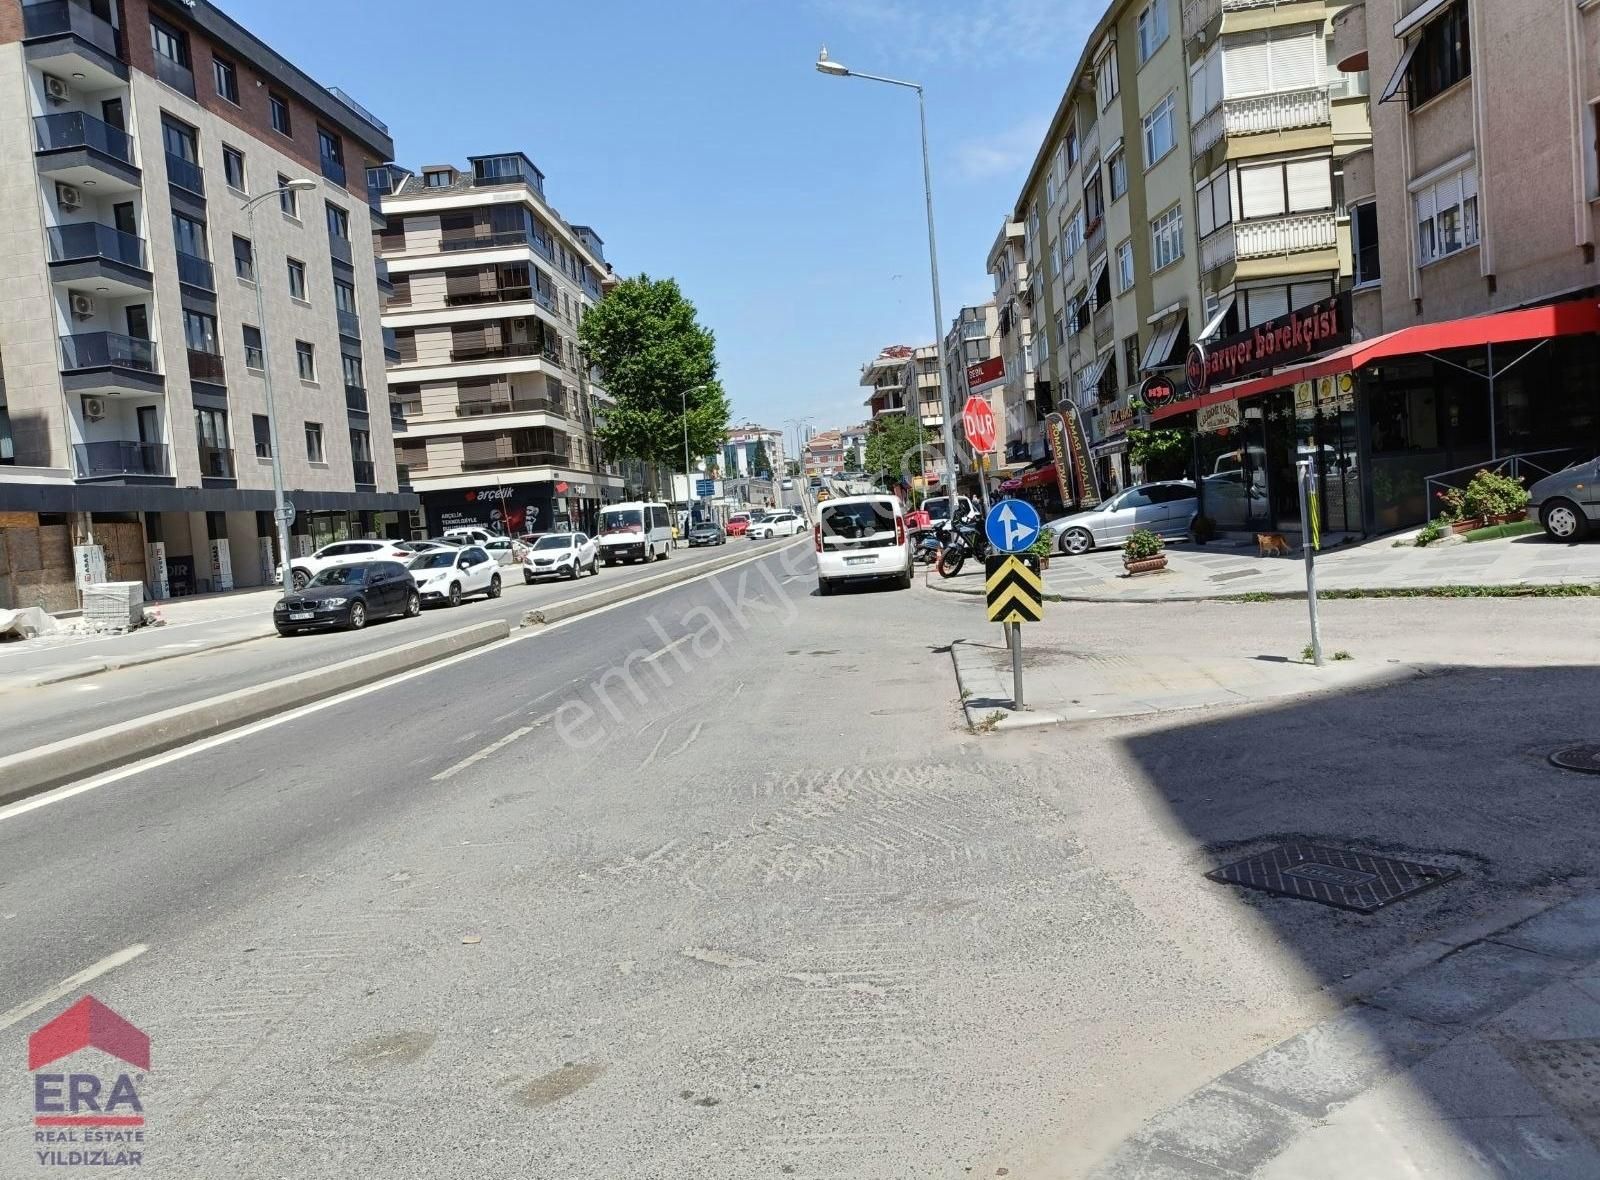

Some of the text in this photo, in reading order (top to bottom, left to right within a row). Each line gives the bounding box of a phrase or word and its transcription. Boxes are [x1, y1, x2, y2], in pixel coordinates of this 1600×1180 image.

[1255, 299, 1337, 359] börekçisi
[966, 414, 994, 436] DUR
[477, 487, 514, 501] arçelik
